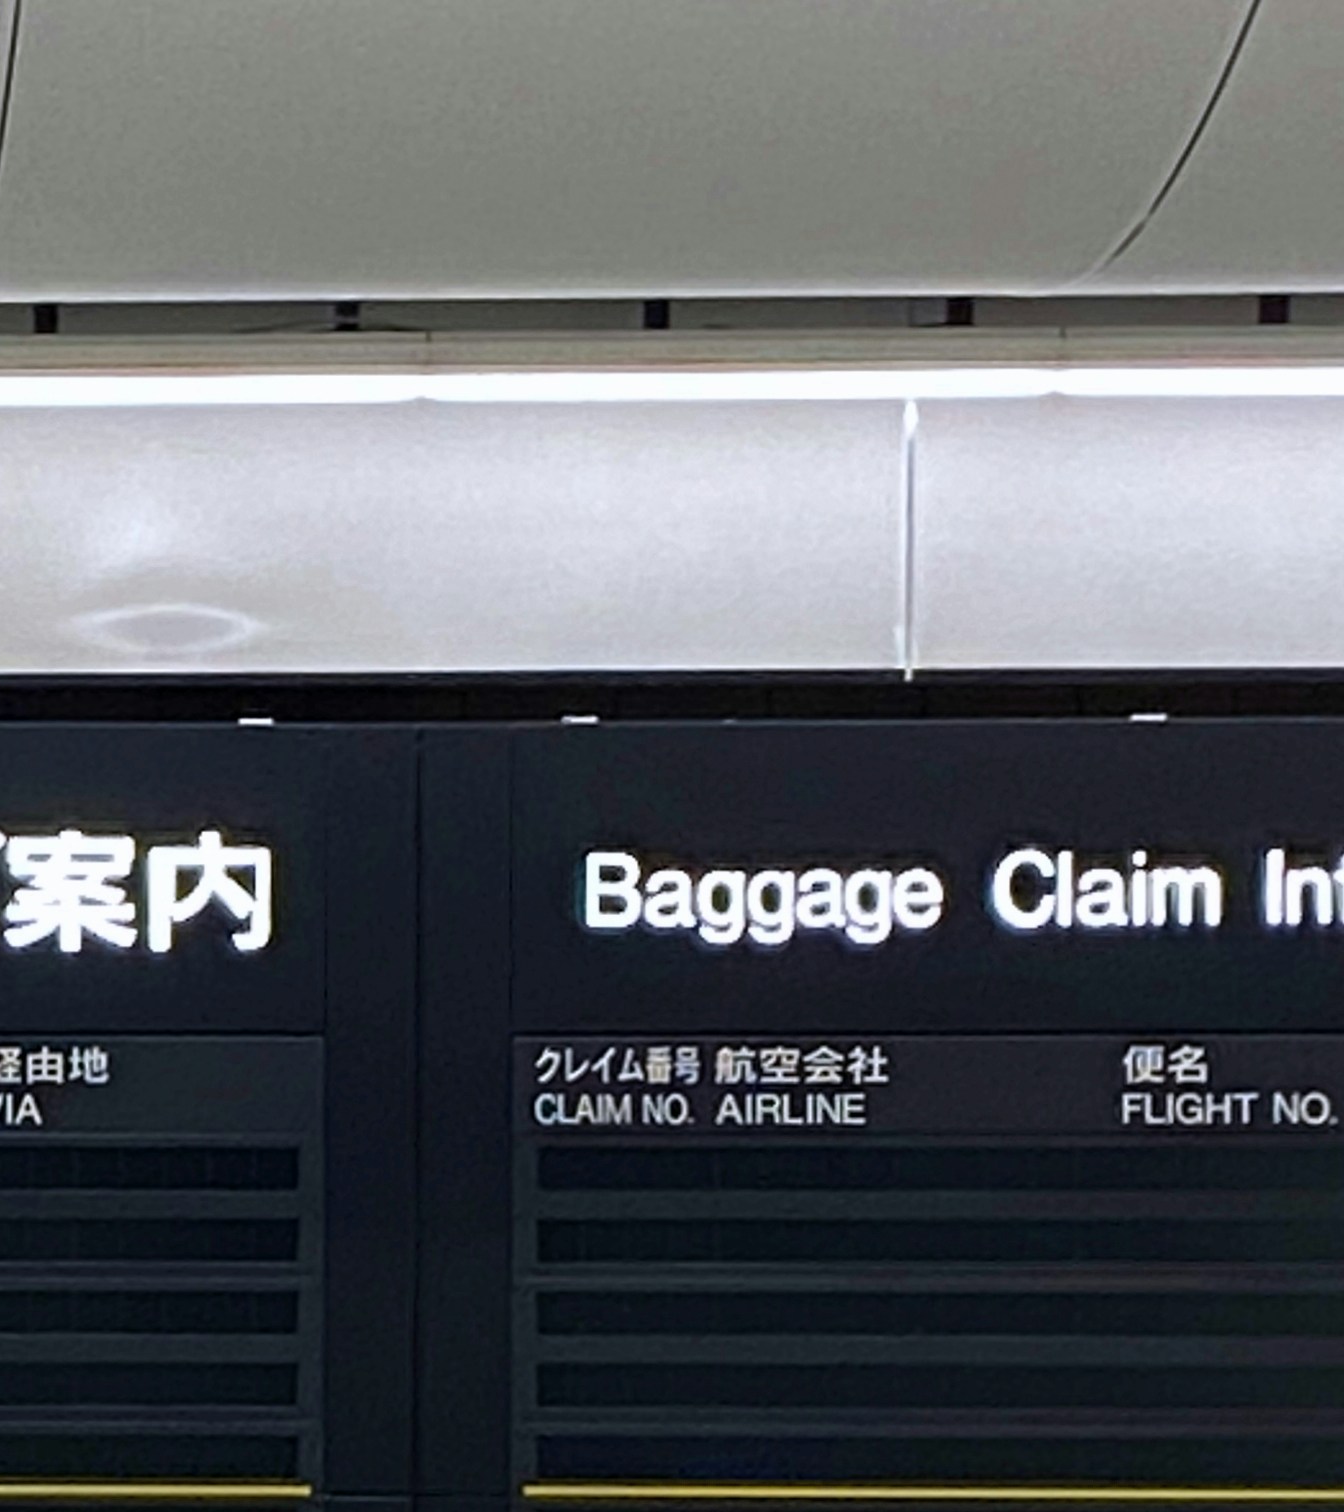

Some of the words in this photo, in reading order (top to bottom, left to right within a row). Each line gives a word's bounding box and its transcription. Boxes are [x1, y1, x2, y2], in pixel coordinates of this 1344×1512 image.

[583, 850, 945, 947] Baggage
[988, 846, 1223, 931] Claim
[534, 1045, 701, 1085] クレイム番号
[714, 1044, 890, 1086] 航空会社
[1122, 1044, 1209, 1085] 便名
[533, 1092, 633, 1126] CLAIM
[641, 1092, 695, 1126] NO.
[714, 1092, 867, 1126] AIRLINE
[1121, 1091, 1260, 1126] FLIGHT
[1272, 1091, 1339, 1126] NO.
